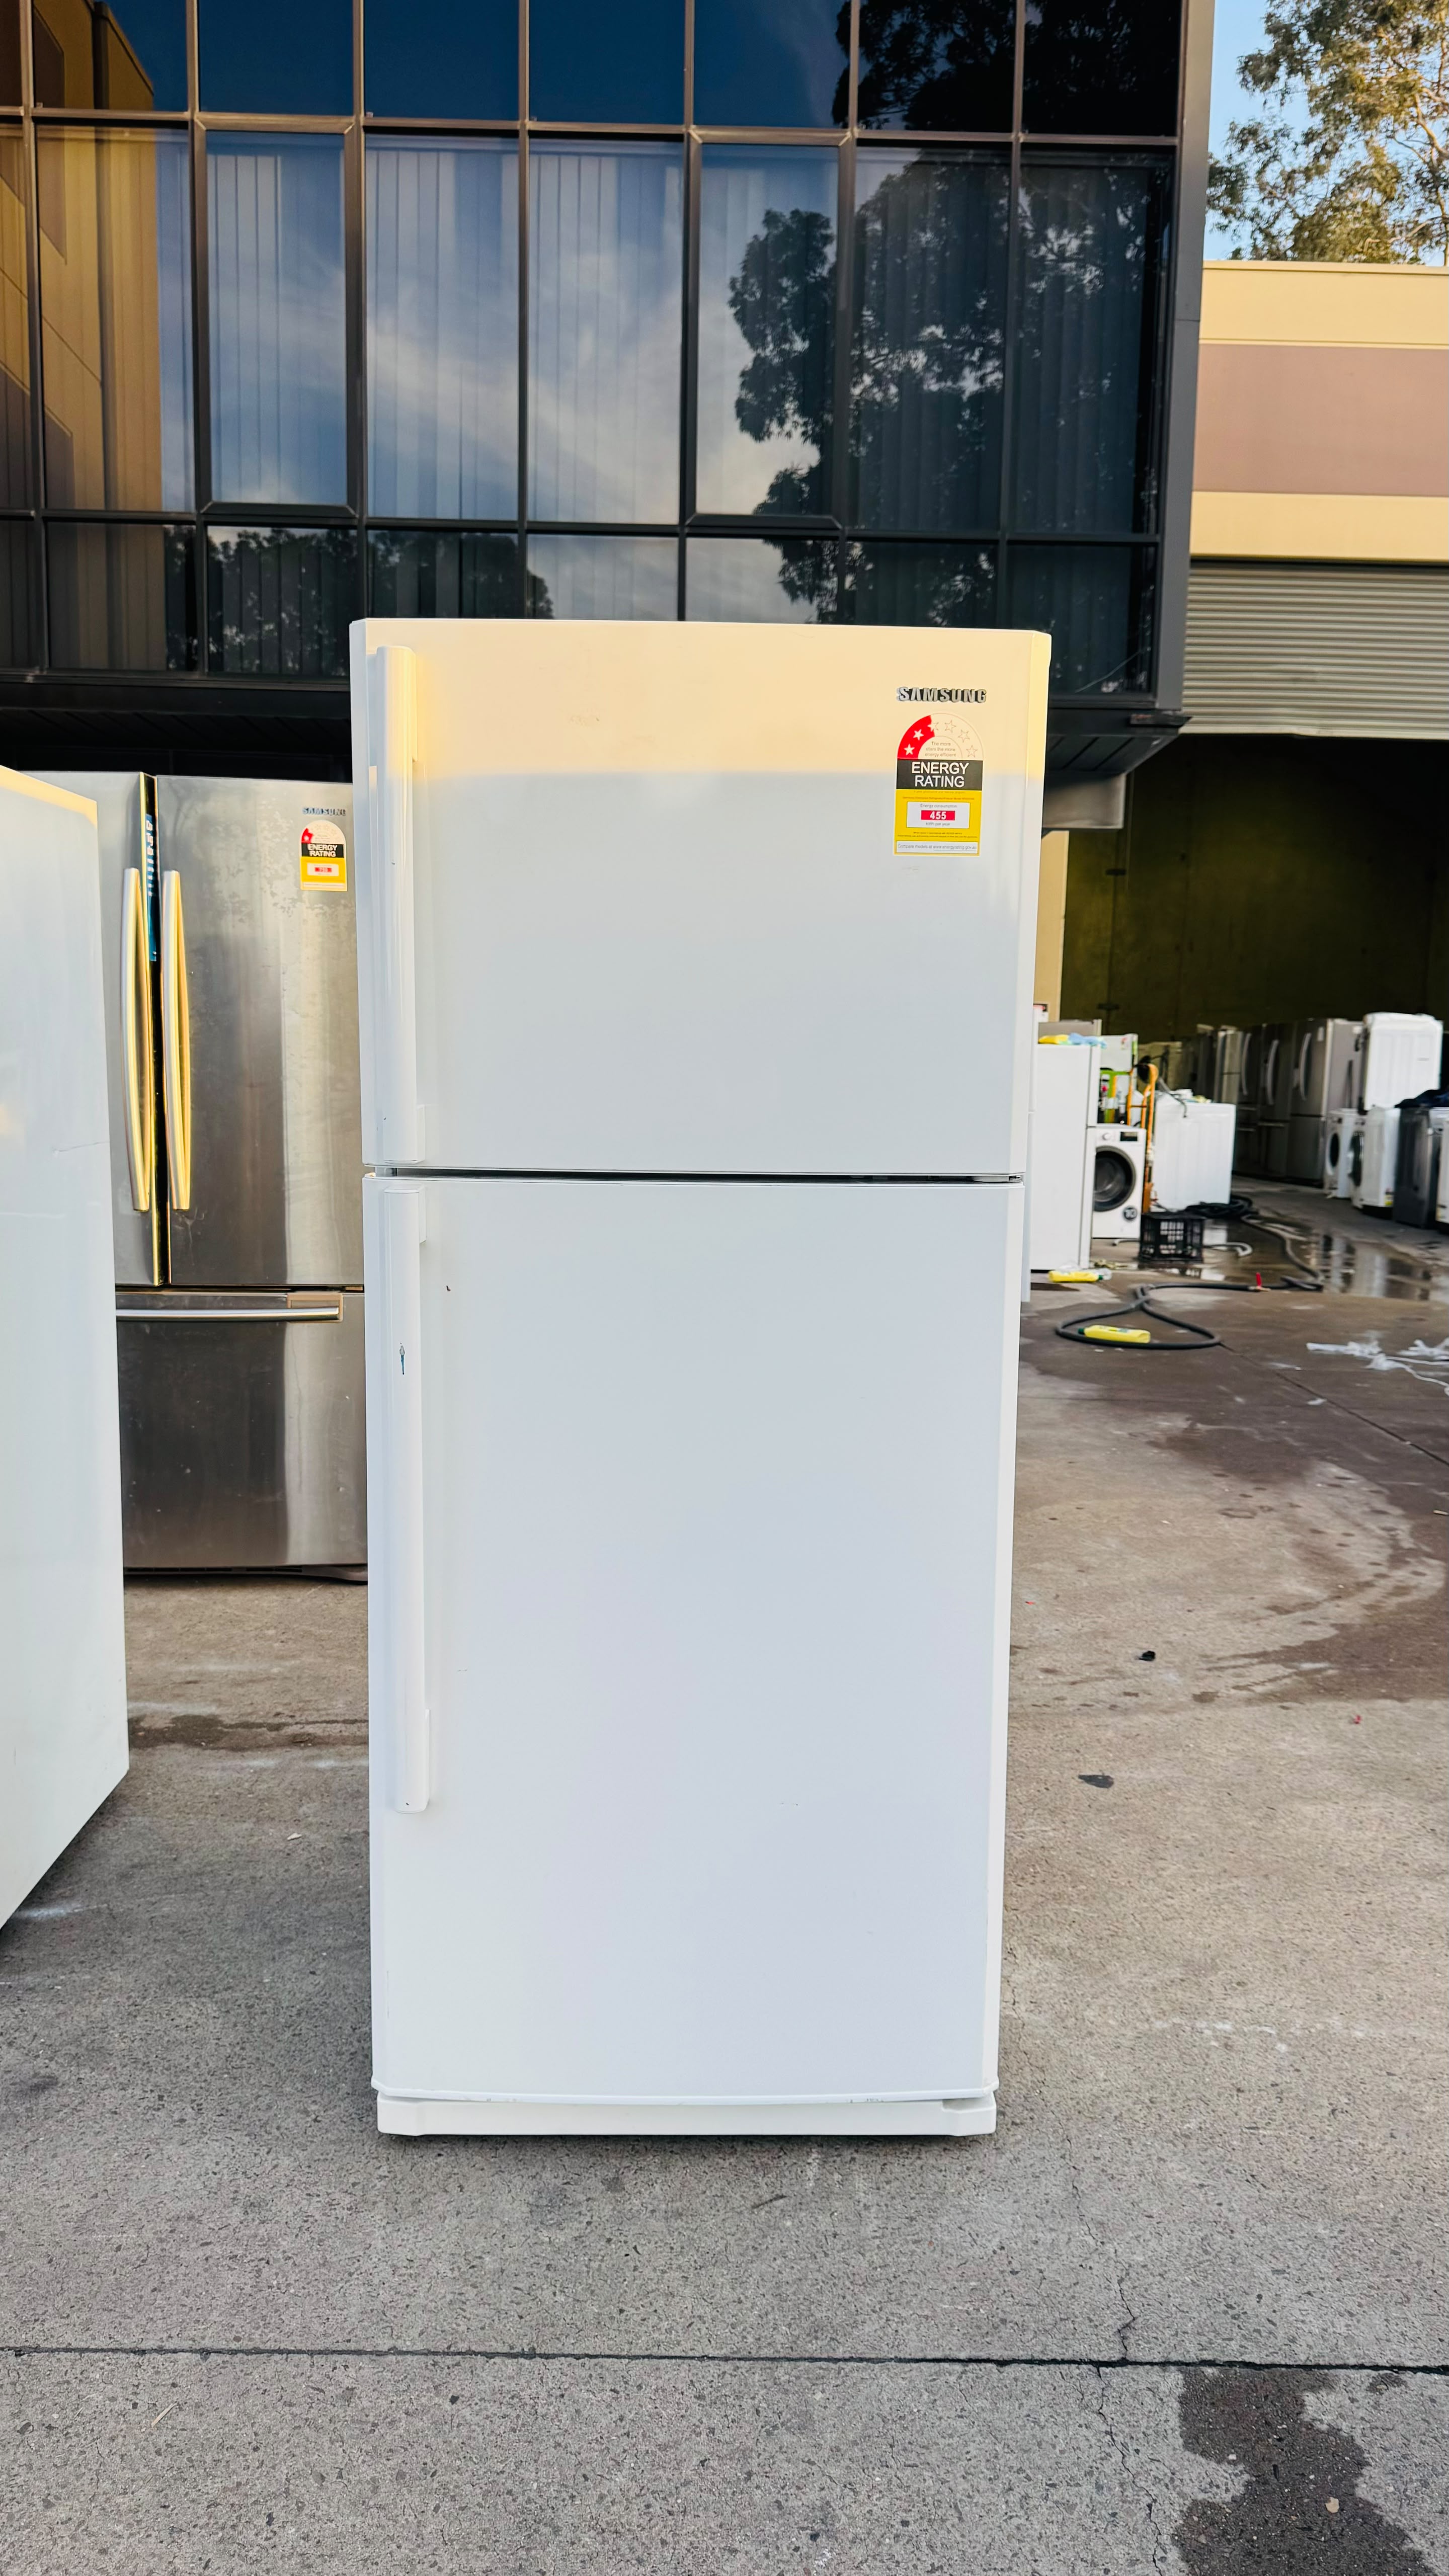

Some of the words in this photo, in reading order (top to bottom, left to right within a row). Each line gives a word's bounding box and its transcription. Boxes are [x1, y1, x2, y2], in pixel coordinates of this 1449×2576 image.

[897, 687, 987, 703] SAMSUNG
[912, 762, 969, 774] ENERGY
[915, 775, 964, 787] RATING
[302, 808, 346, 816] SAMSUNG
[930, 811, 946, 820] 455
